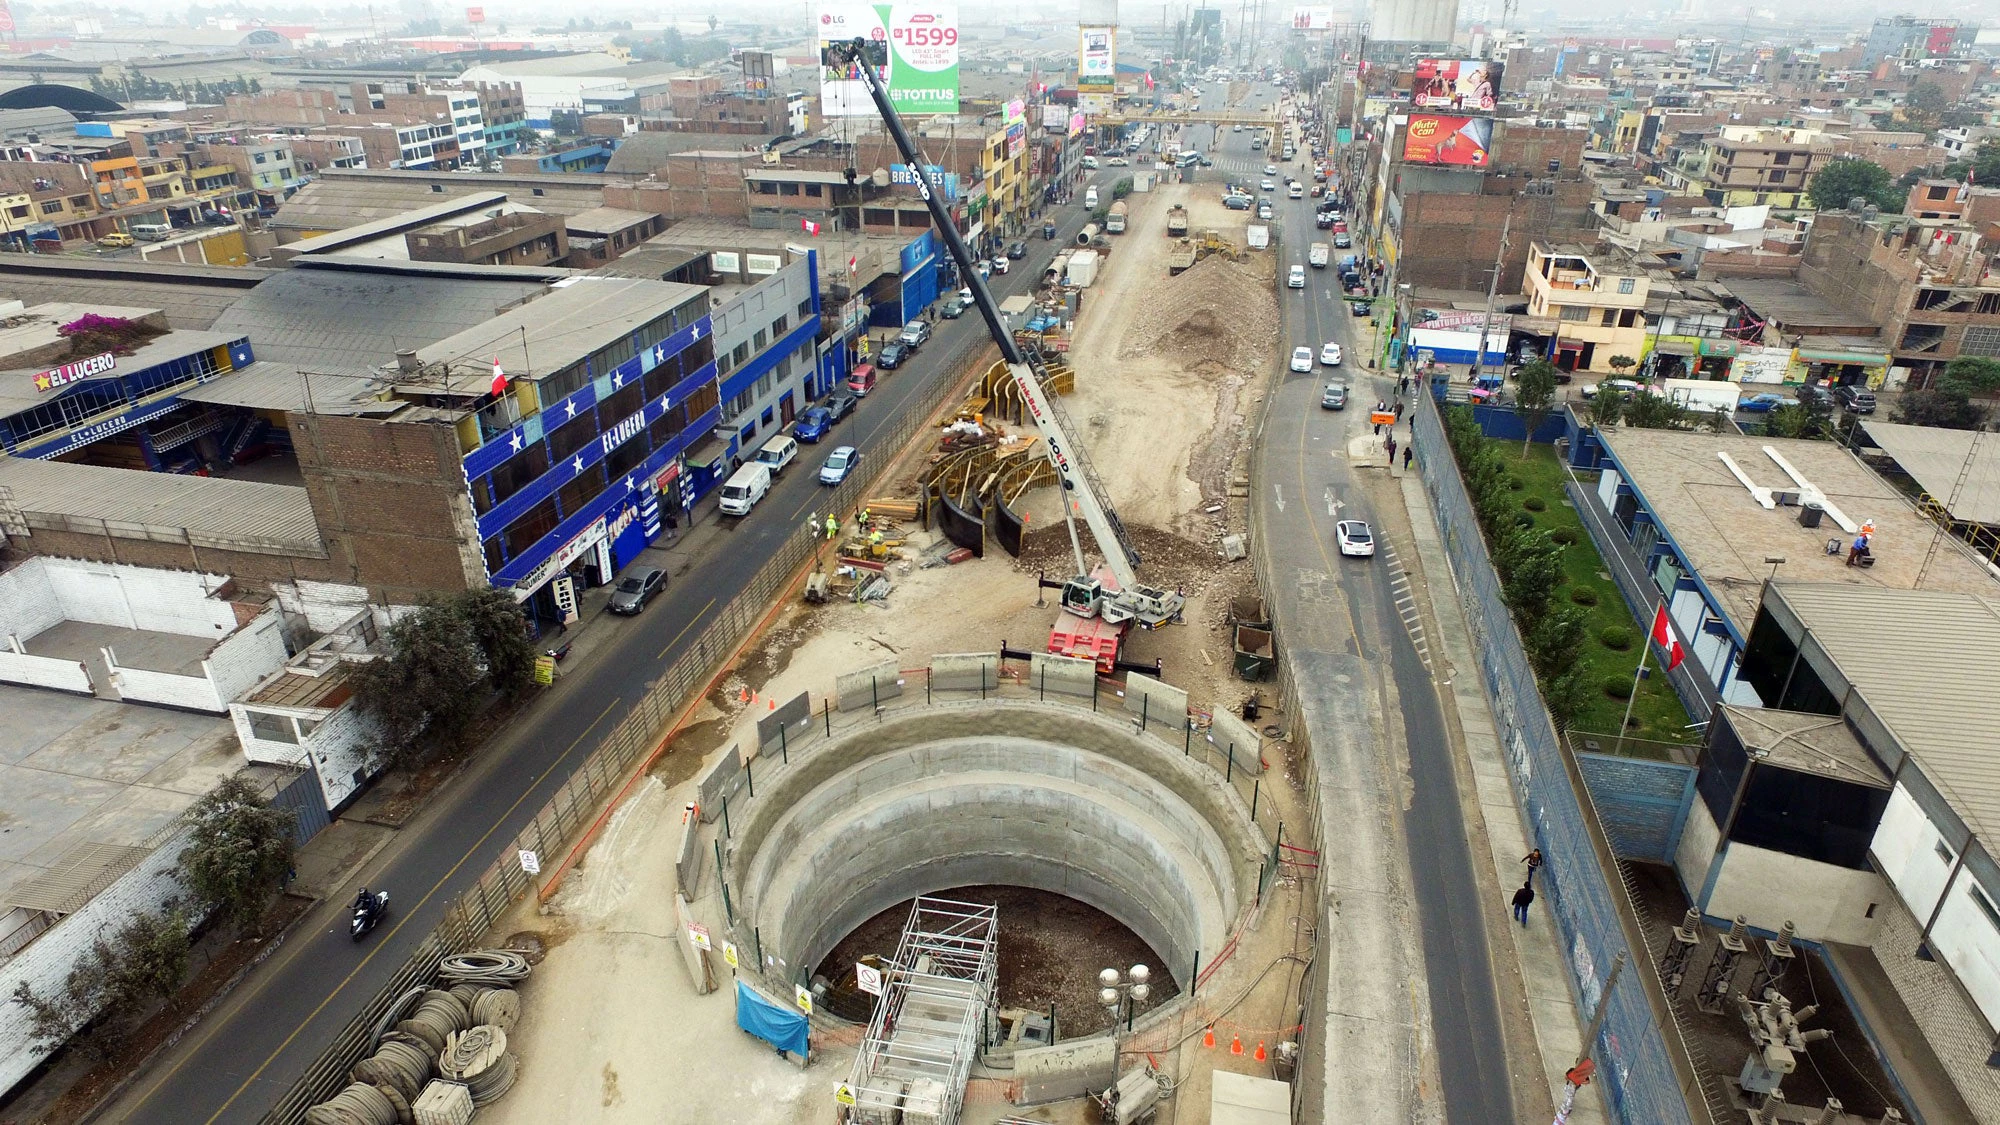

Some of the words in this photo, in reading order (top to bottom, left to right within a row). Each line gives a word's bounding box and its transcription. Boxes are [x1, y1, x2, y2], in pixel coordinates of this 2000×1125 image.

[832, 15, 845, 24] LG
[905, 27, 958, 46] 1599
[903, 88, 954, 101] TOTTUS
[1413, 120, 1439, 130] Nutri
[1417, 128, 1435, 136] can
[1426, 317, 1461, 329] PINTURA
[49, 367, 68, 387] EL
[66, 353, 115, 382] LUCERO
[1017, 377, 1042, 418] Link-Belt
[71, 433, 85, 443] EL
[90, 416, 126, 435] LUCERO
